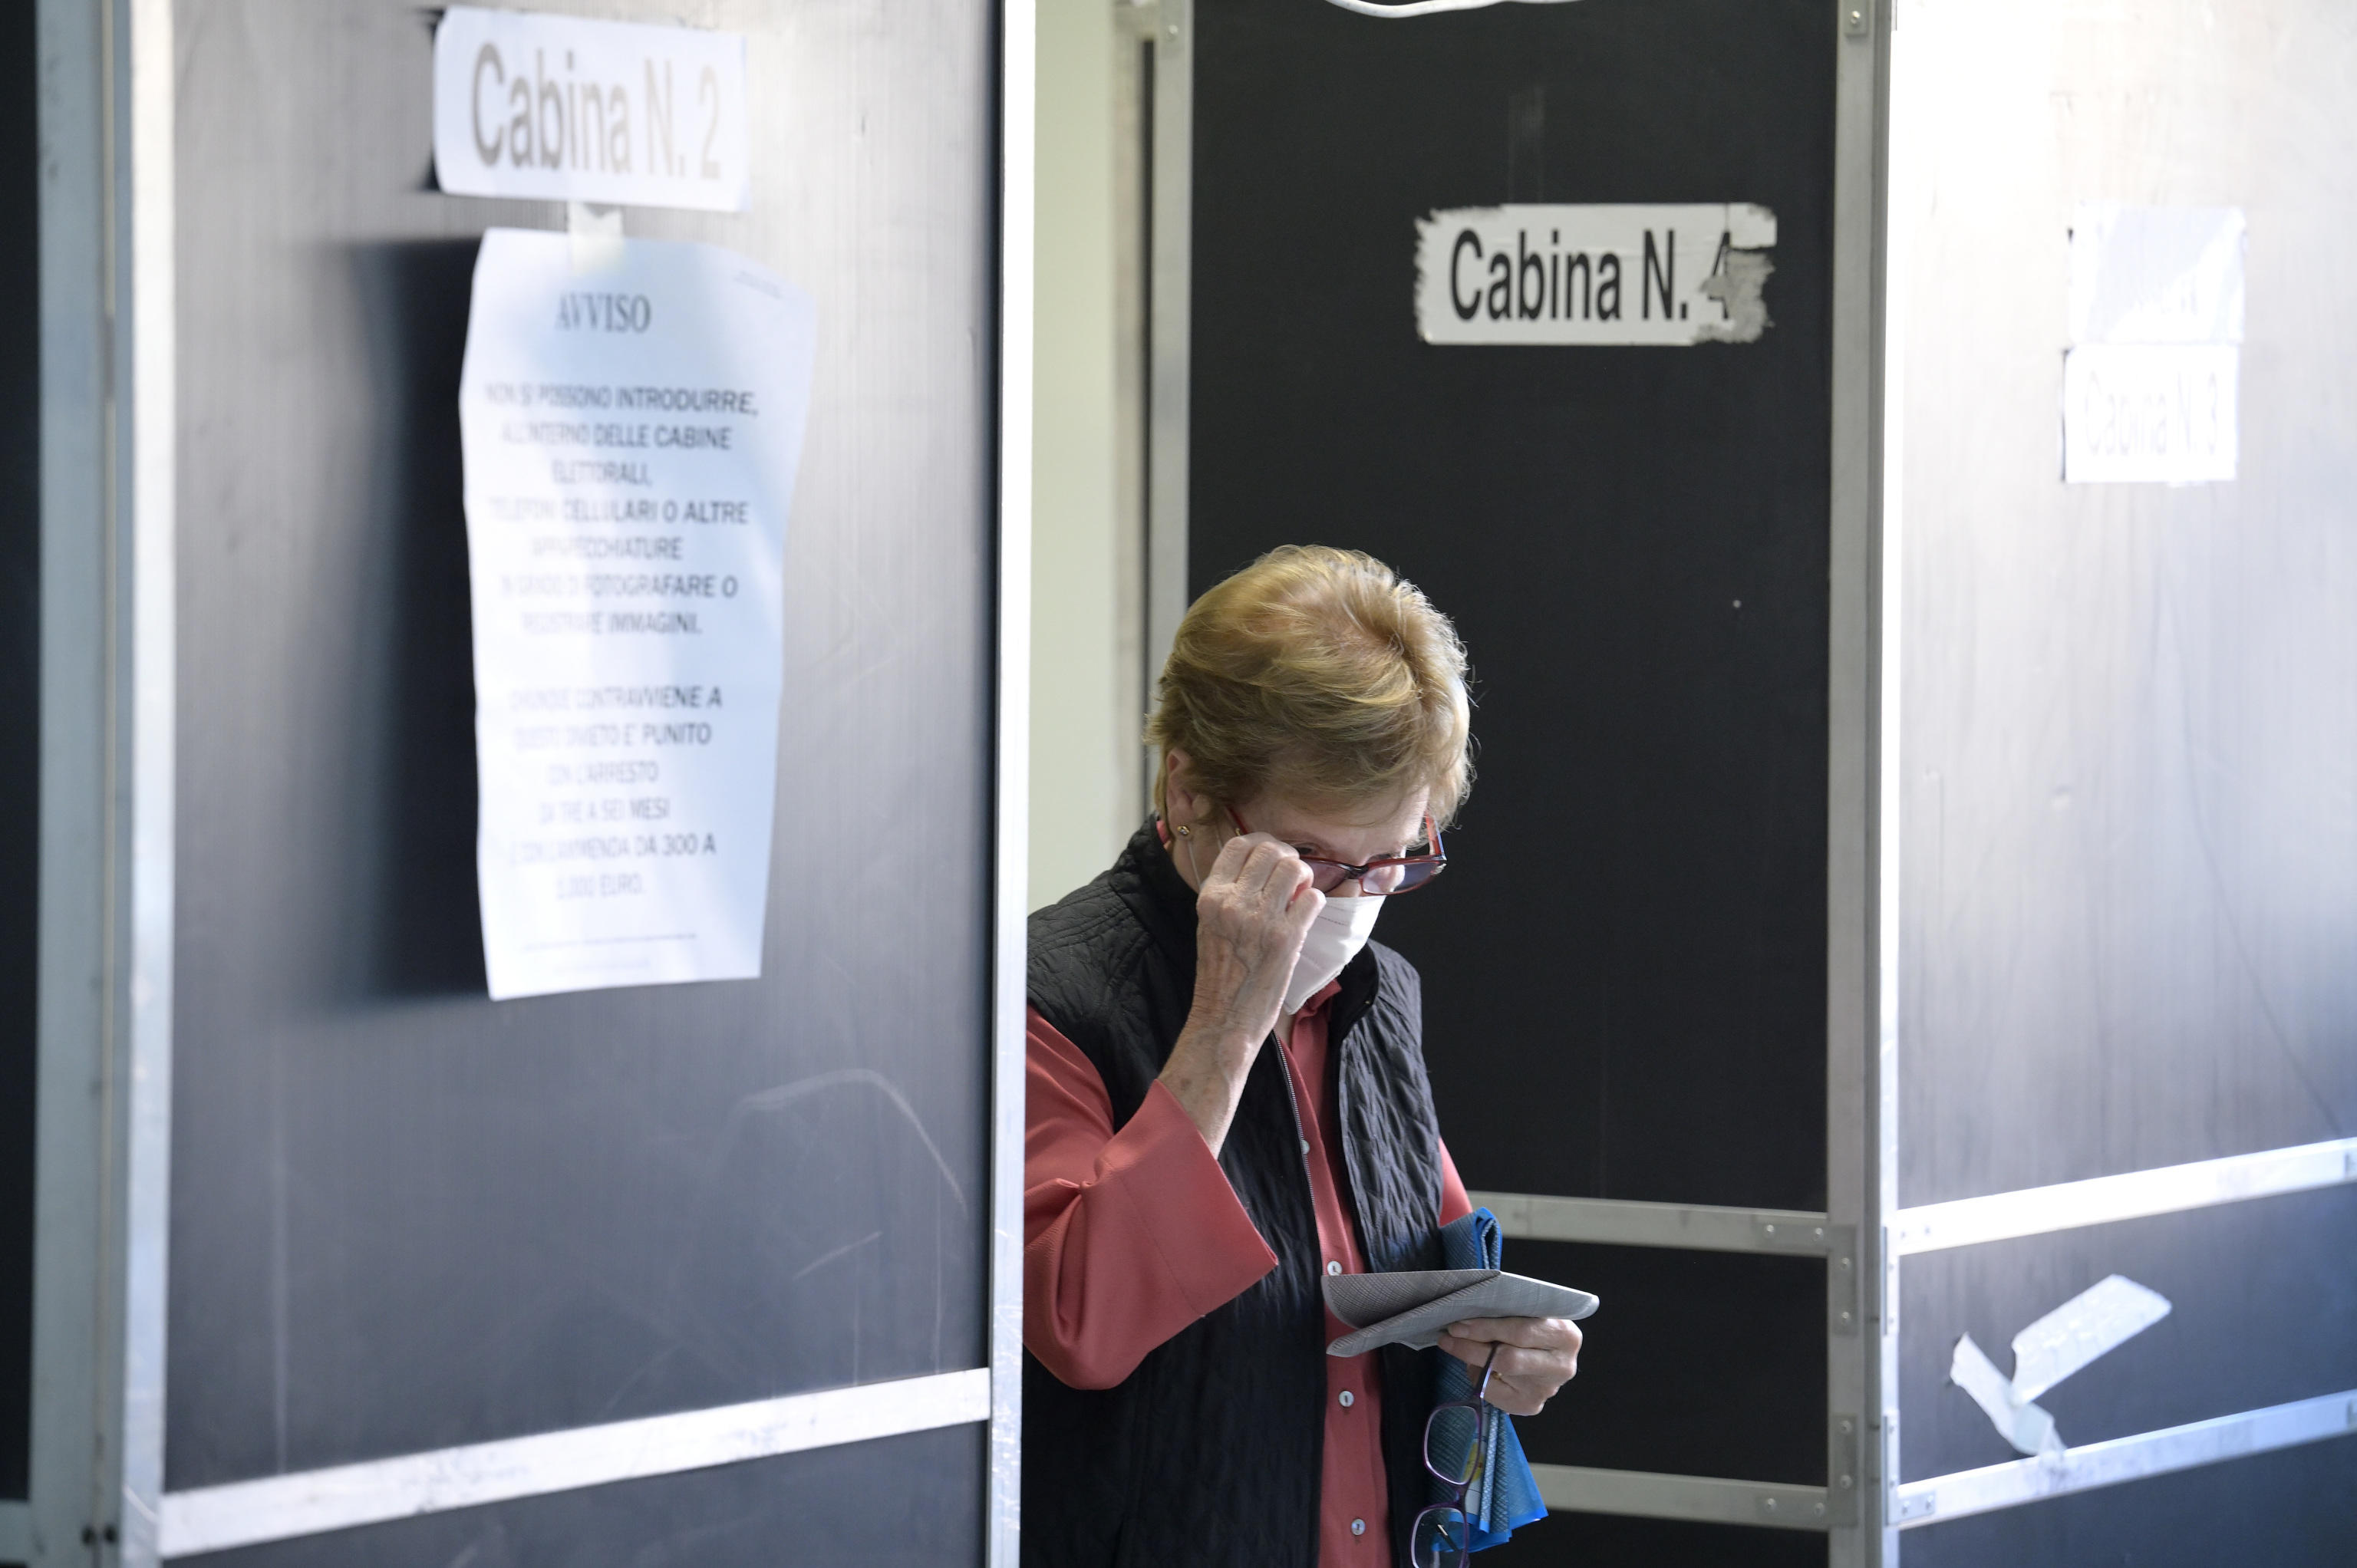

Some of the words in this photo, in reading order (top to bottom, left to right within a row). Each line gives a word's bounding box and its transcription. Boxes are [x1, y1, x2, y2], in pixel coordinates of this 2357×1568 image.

[472, 41, 631, 175] Cabina
[643, 58, 686, 179] N.
[699, 65, 721, 180] 2
[1449, 229, 1621, 321] Cabina
[1641, 229, 1689, 321] N.
[555, 291, 652, 334] AVVISO
[617, 385, 759, 417] INTRODURRE,
[592, 422, 651, 449] DELLE
[654, 424, 733, 450] CABINE
[662, 499, 678, 524] O
[681, 499, 750, 525] ALTRE
[722, 575, 739, 598] O
[706, 684, 724, 709] A
[641, 721, 713, 746] PUNITO
[629, 796, 671, 820] MESI
[661, 832, 698, 857] 300
[701, 831, 717, 856] A
